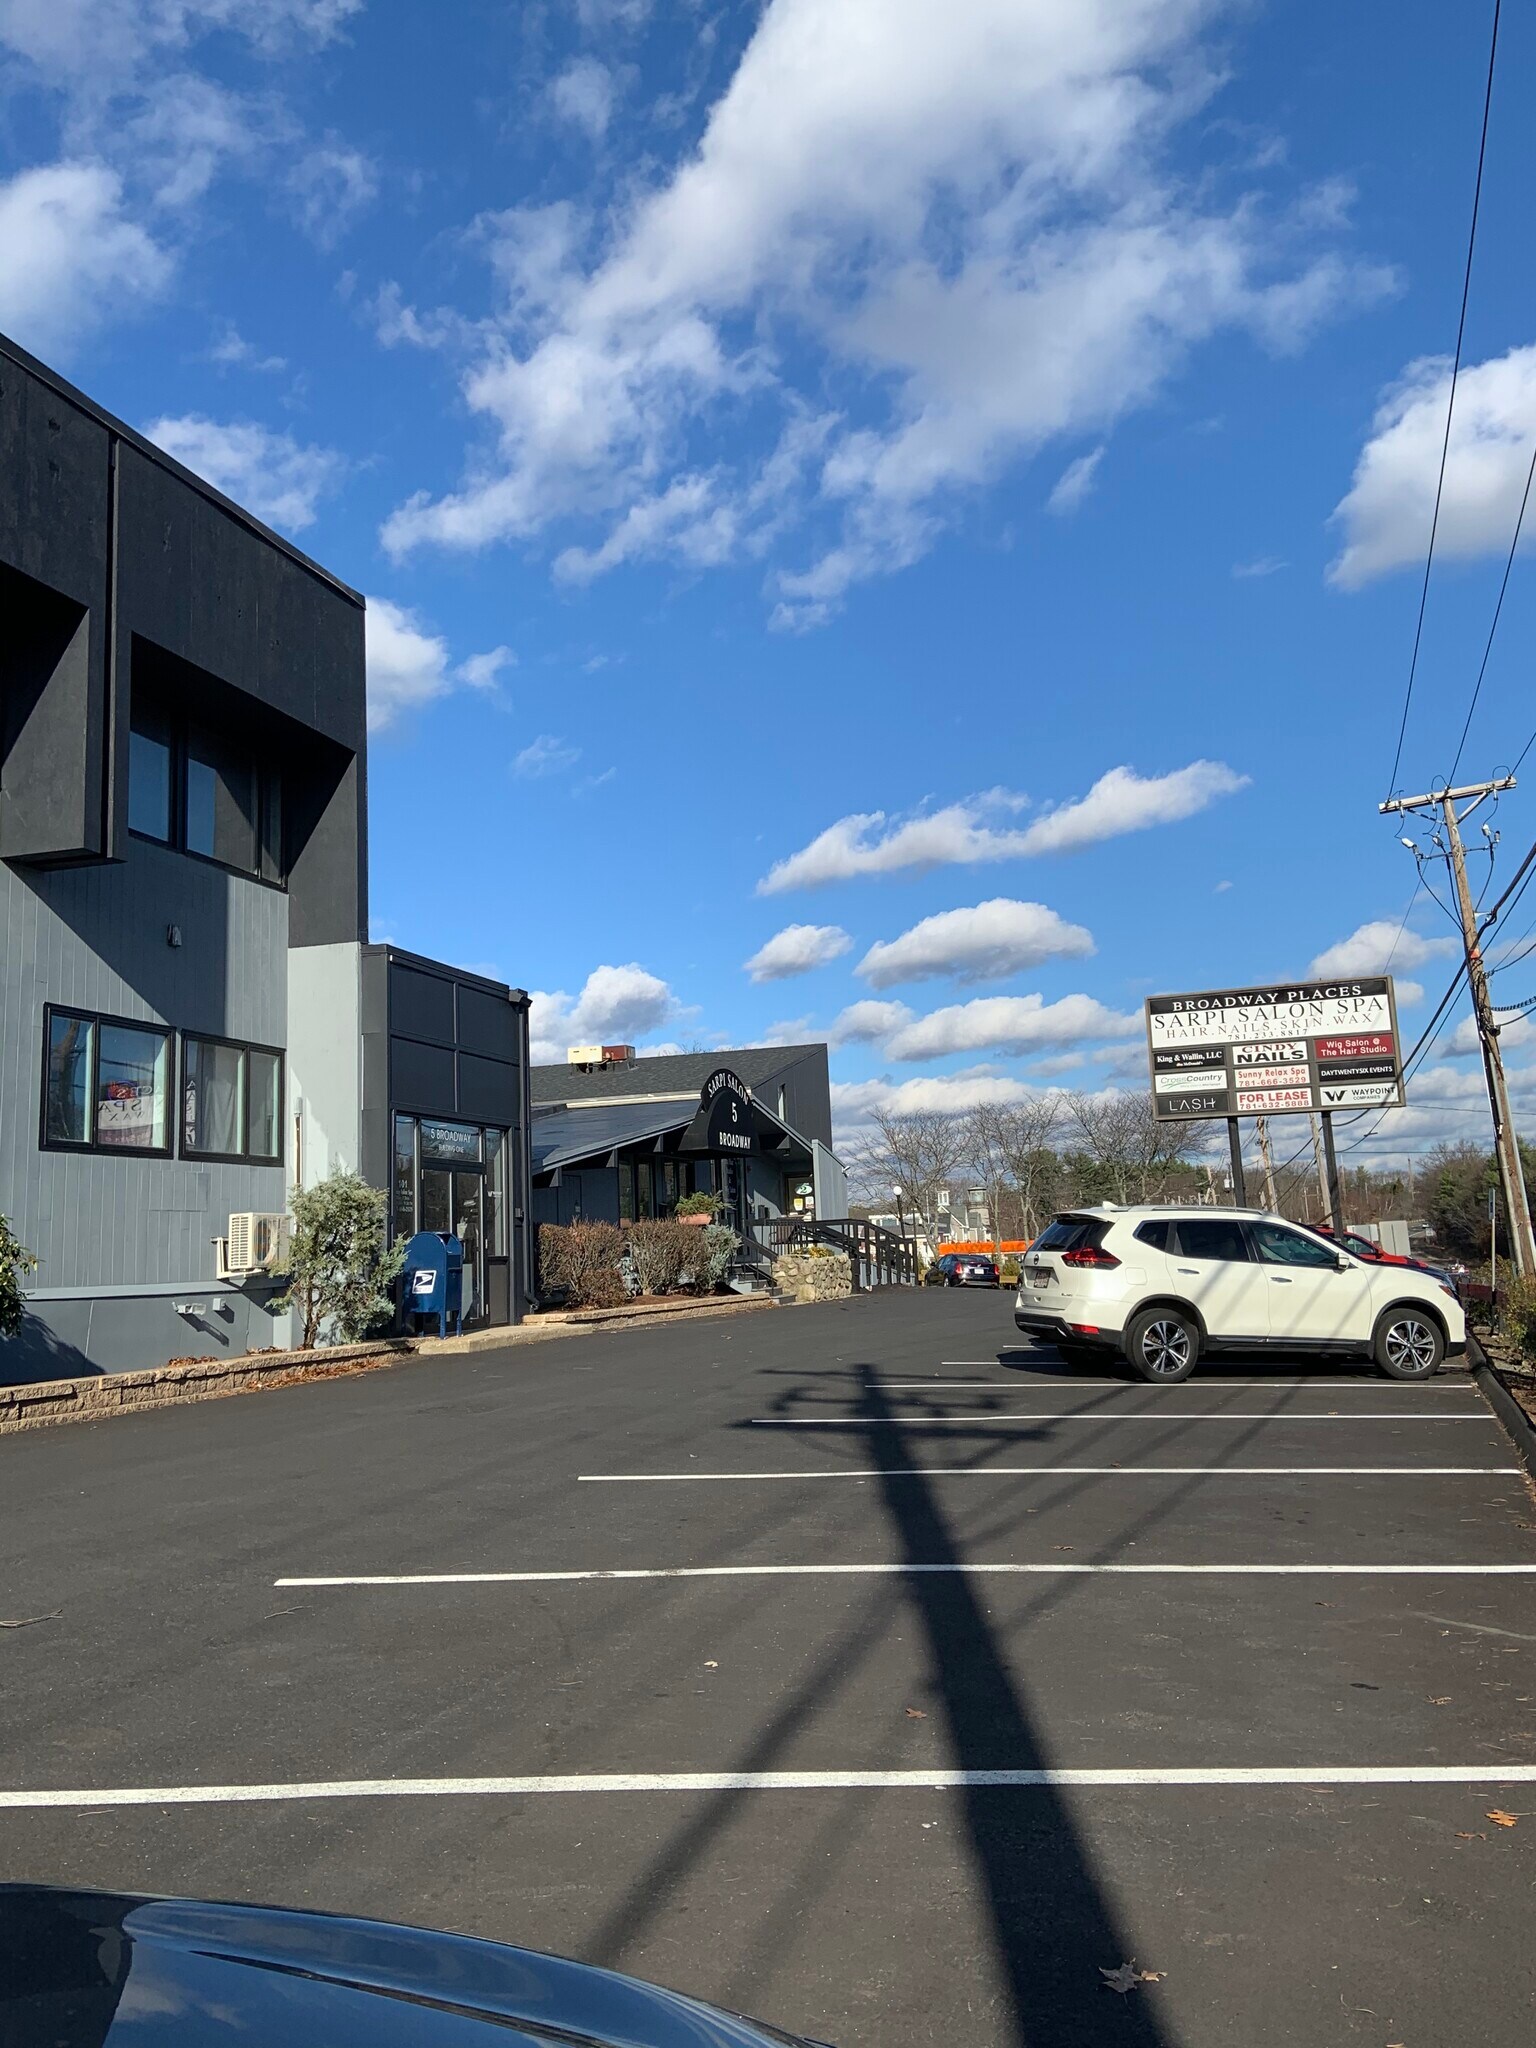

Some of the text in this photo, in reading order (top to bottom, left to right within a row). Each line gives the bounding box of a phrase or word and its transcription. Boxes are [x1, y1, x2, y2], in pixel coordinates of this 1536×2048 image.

[1172, 985, 1362, 1012] BROADWAY PLACES
[1154, 997, 1384, 1030] SARPI SALON SPA
[1242, 1043, 1297, 1054] CINDY
[1321, 1046, 1388, 1057] The Hair Studio
[1326, 1041, 1343, 1050] Wig
[1345, 1040, 1370, 1048] Salon
[1157, 1056, 1174, 1064] King
[1174, 1054, 1181, 1062] &
[1206, 1051, 1223, 1060] LLC
[1237, 1050, 1305, 1064] NAILS
[1238, 1067, 1306, 1079] Sunny Relax Spa
[1321, 1065, 1393, 1077] DAYTWENTYSIX EVENTS
[1238, 1077, 1307, 1087] 781-666-3529
[708, 1073, 749, 1106] SARPI SALON
[1351, 1087, 1396, 1096] WAYPOINT
[1239, 1091, 1309, 1104] FOR LEASE
[1169, 1098, 1217, 1111] LASH
[1239, 1100, 1310, 1110] 781-632-5888
[732, 1102, 738, 1123] 5
[431, 1128, 472, 1143] 5 BROADWAY
[719, 1131, 751, 1150] BROADWAY
